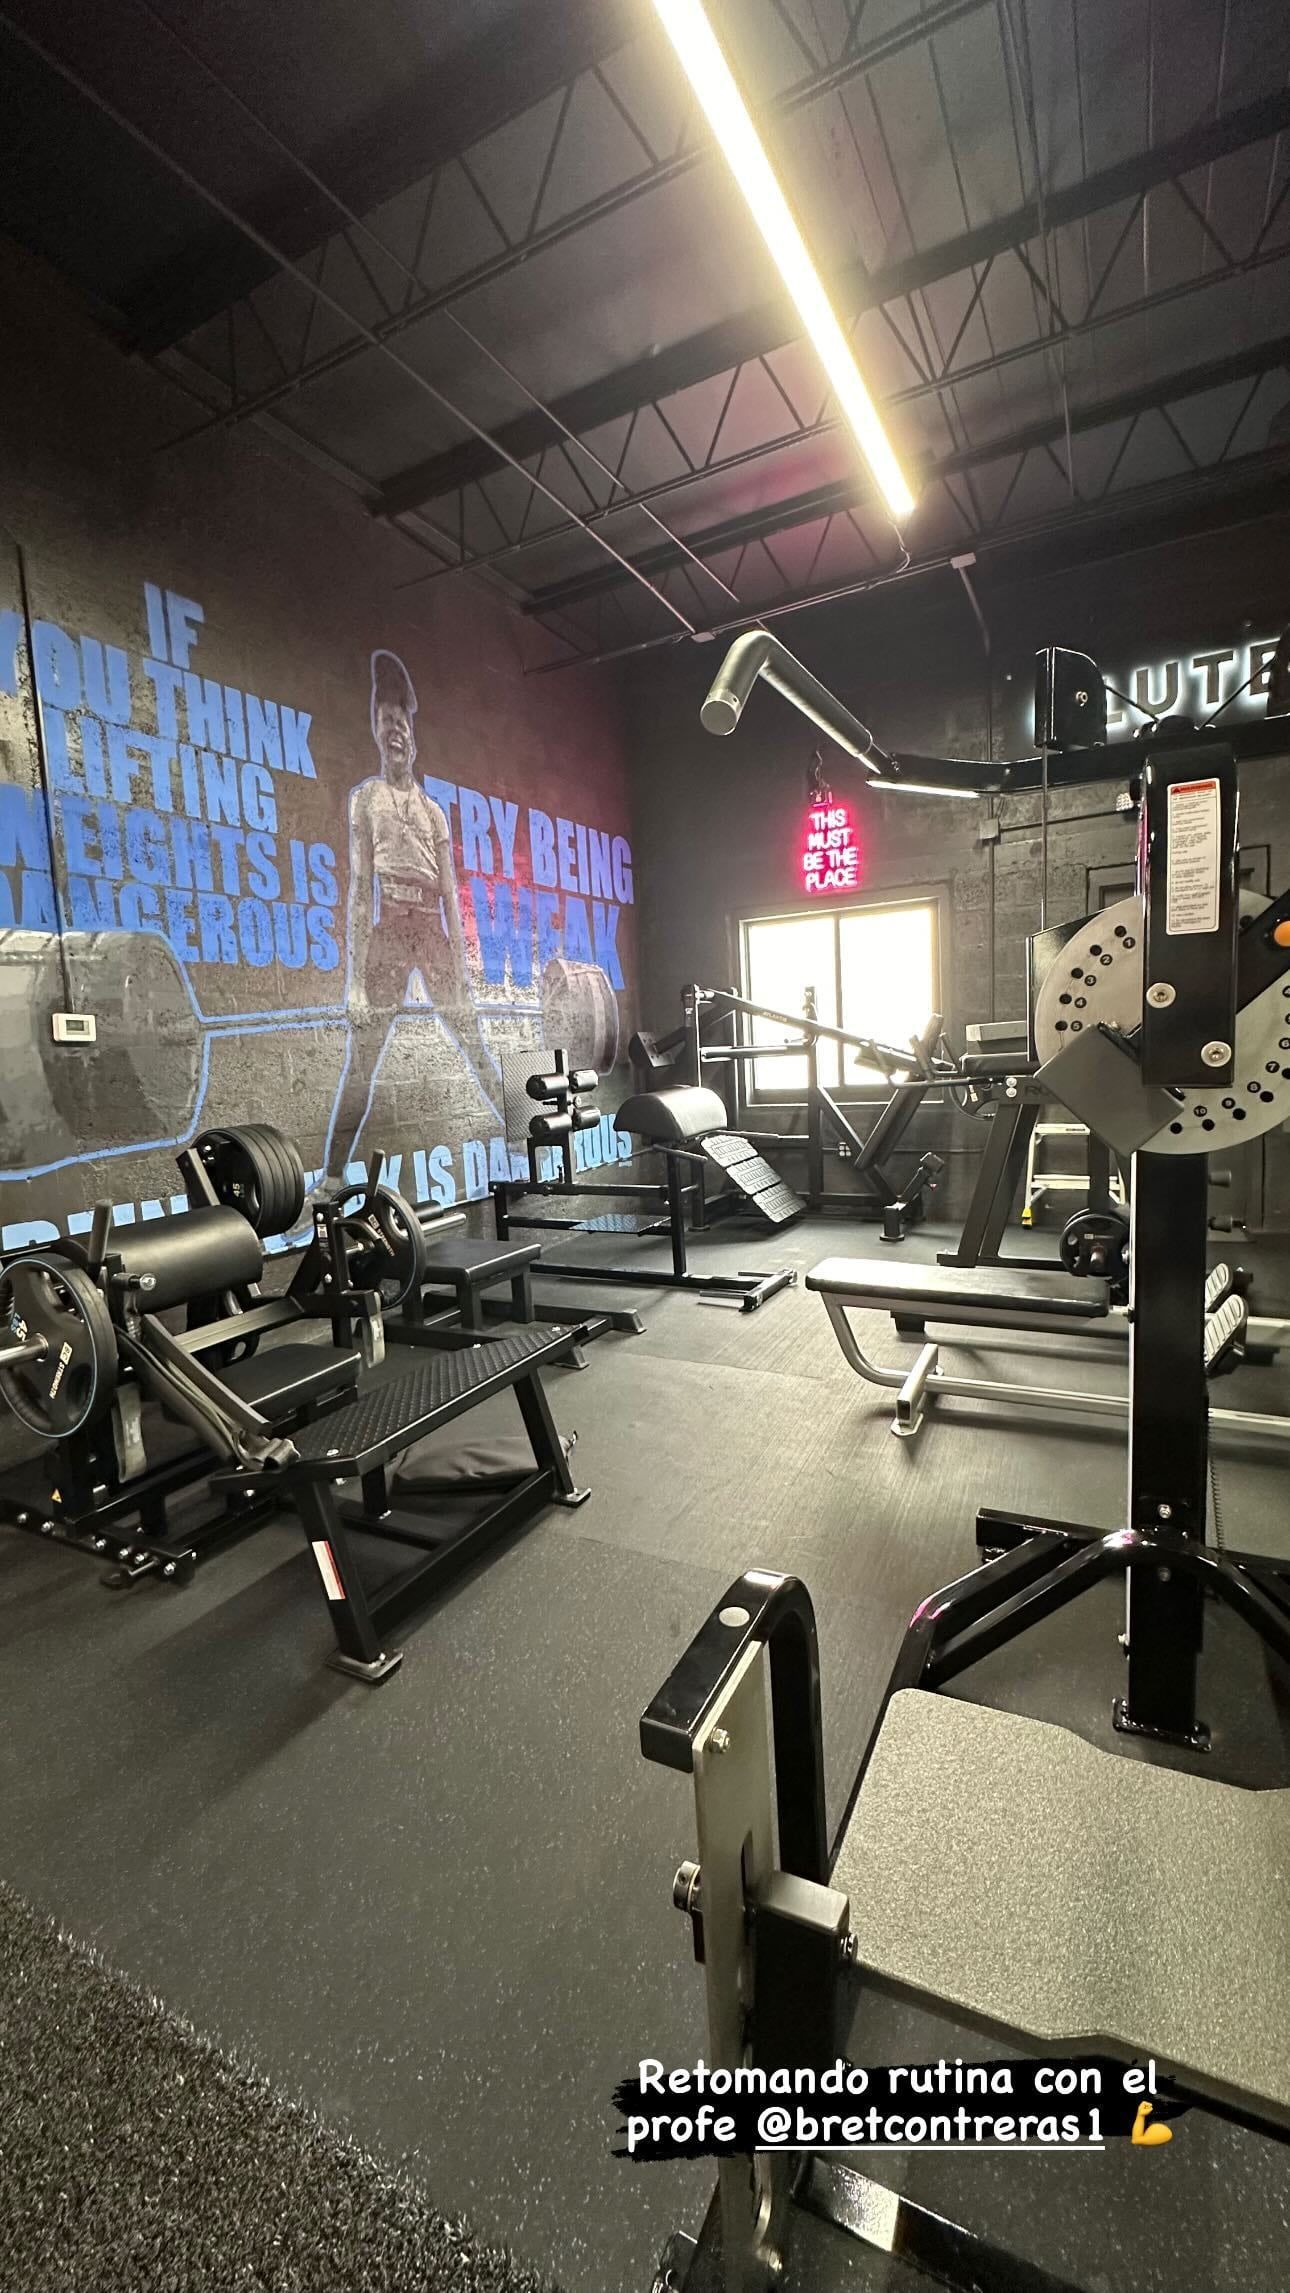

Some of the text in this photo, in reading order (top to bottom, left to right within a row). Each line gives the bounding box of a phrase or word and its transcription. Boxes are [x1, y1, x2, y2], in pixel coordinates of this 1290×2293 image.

[143, 581, 205, 670] IF
[143, 657, 317, 779] THINK
[42, 703, 278, 834] LIFTING
[424, 774, 634, 905] TRY BEING
[808, 828, 852, 851] MUST
[809, 808, 846, 830] THIS
[289, 839, 338, 906] IS
[803, 846, 859, 872] BE THE
[805, 867, 857, 892] PLACE
[470, 876, 625, 990] WEAK
[413, 1145, 456, 1210] IS
[16, 1319, 28, 1341] 45
